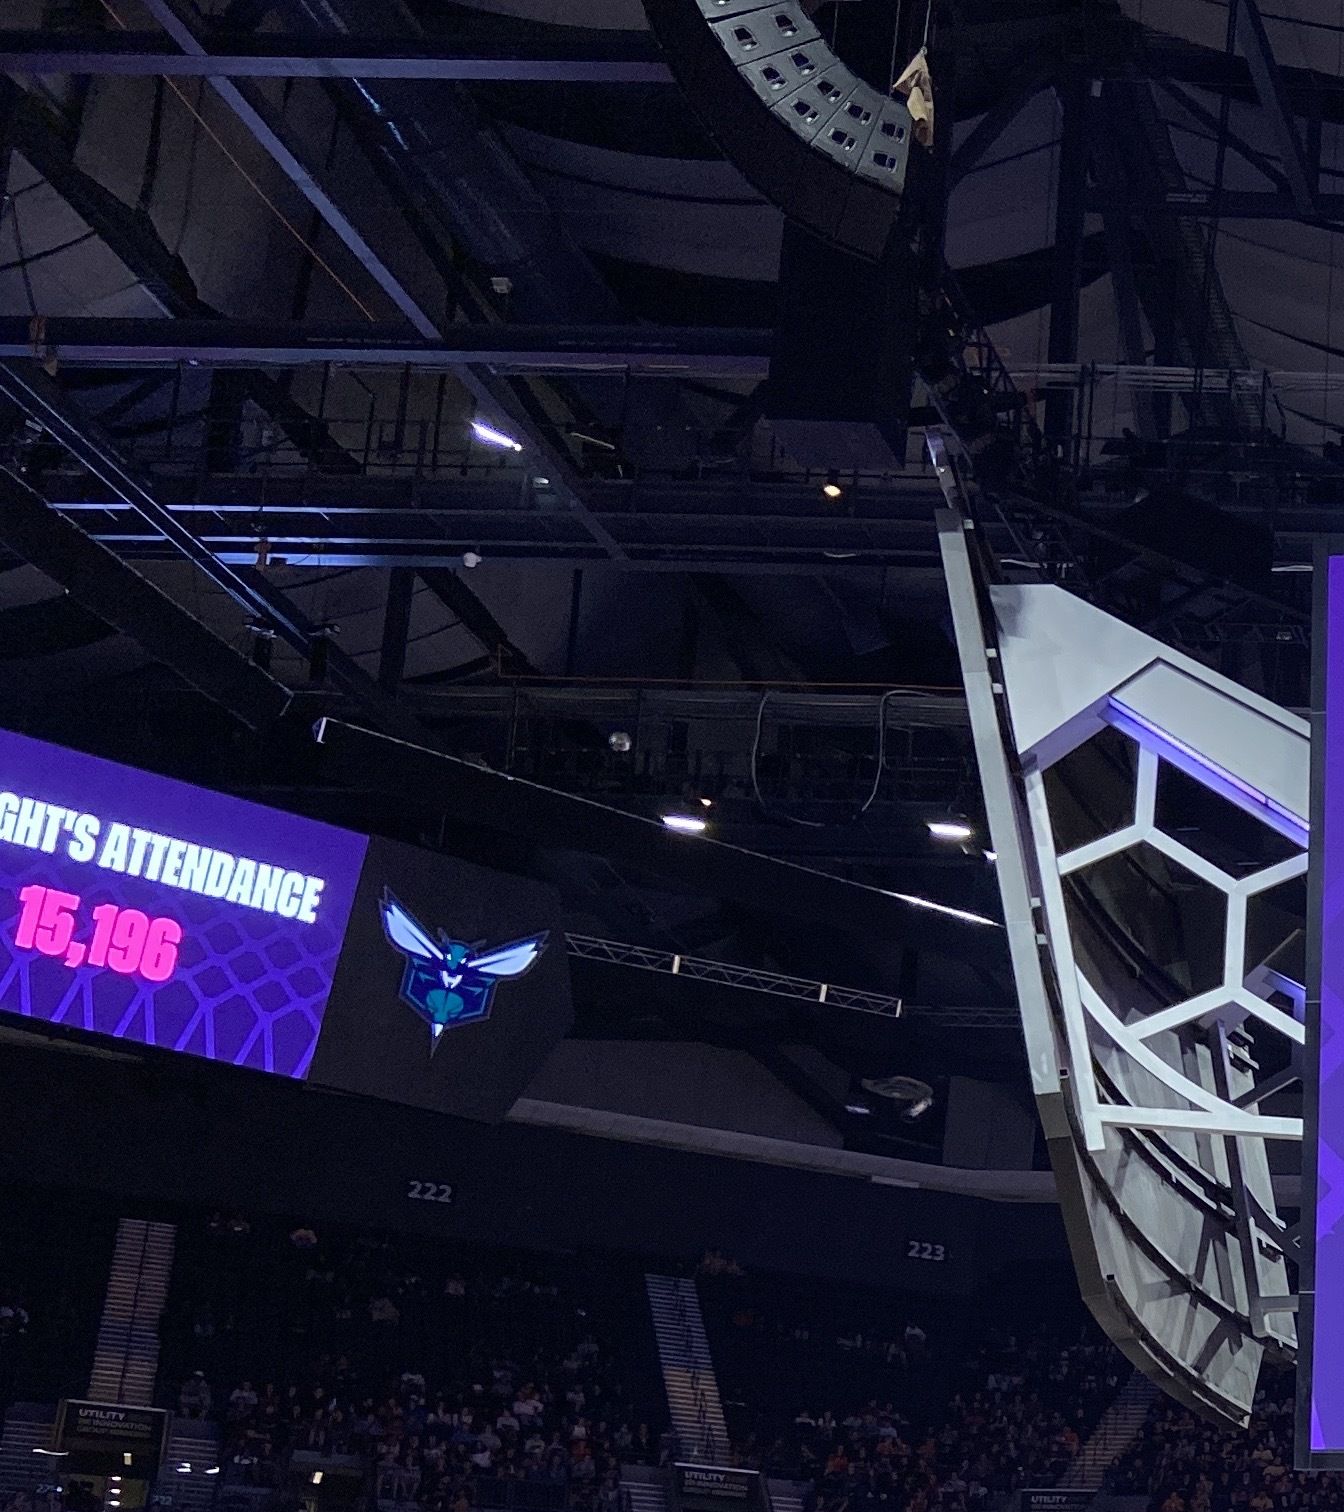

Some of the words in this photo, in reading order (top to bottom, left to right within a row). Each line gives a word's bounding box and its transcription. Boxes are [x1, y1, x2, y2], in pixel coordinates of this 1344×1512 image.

[98, 822, 325, 924] ATTENDANCE
[14, 884, 183, 982] 15,196
[407, 1180, 452, 1203] 222
[907, 1240, 946, 1262] 223
[78, 1407, 125, 1422] UTILITY
[684, 1470, 726, 1483] UTILITY
[1030, 1496, 1067, 1505] UTILITY
